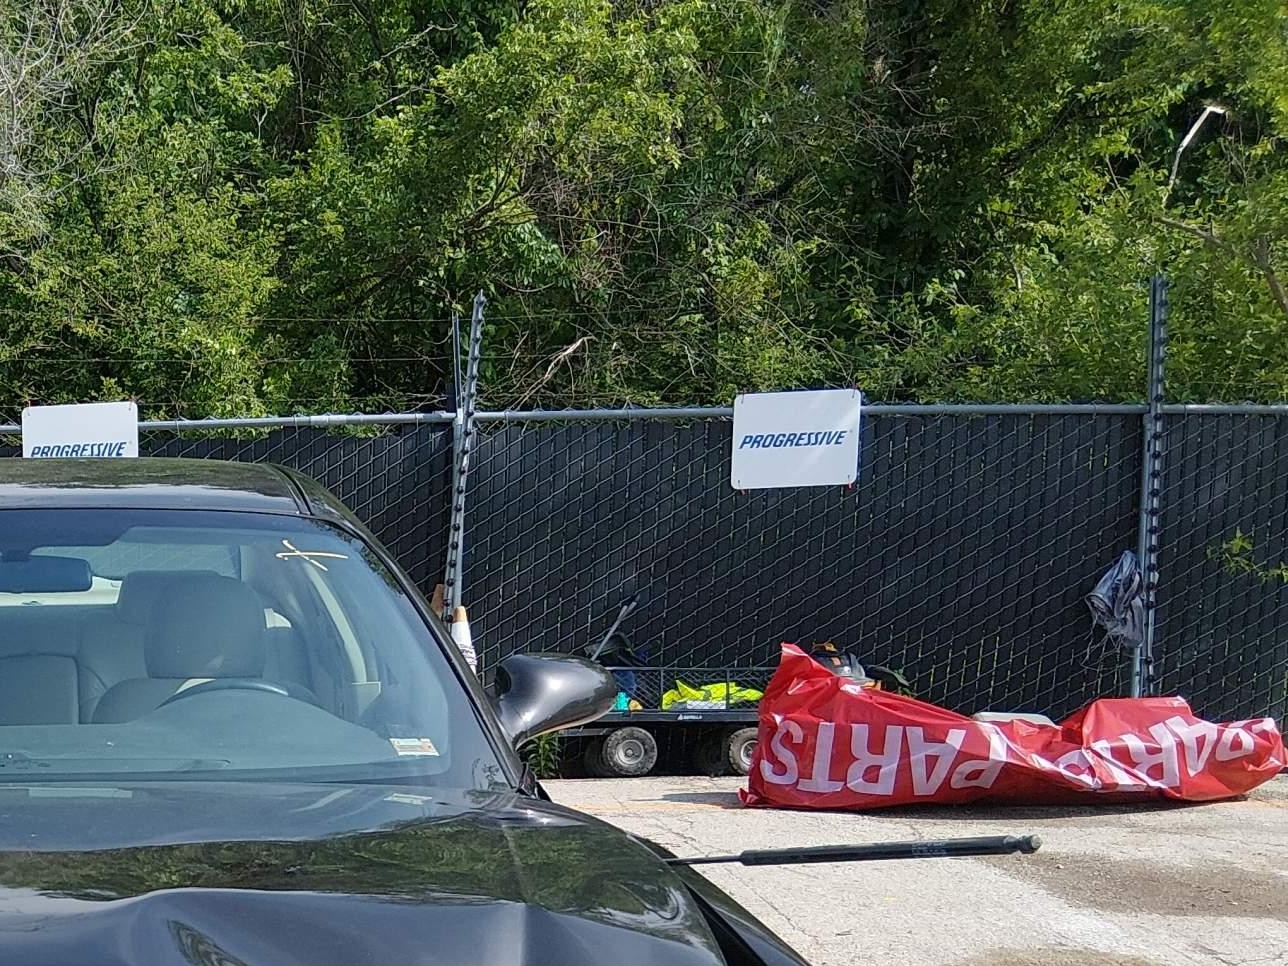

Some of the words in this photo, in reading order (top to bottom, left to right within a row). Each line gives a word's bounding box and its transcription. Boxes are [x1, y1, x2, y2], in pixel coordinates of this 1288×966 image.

[31, 441, 127, 458] PROGRESSIVE
[738, 430, 847, 450] PROGRESSIVE
[759, 719, 1010, 797] PARTS
